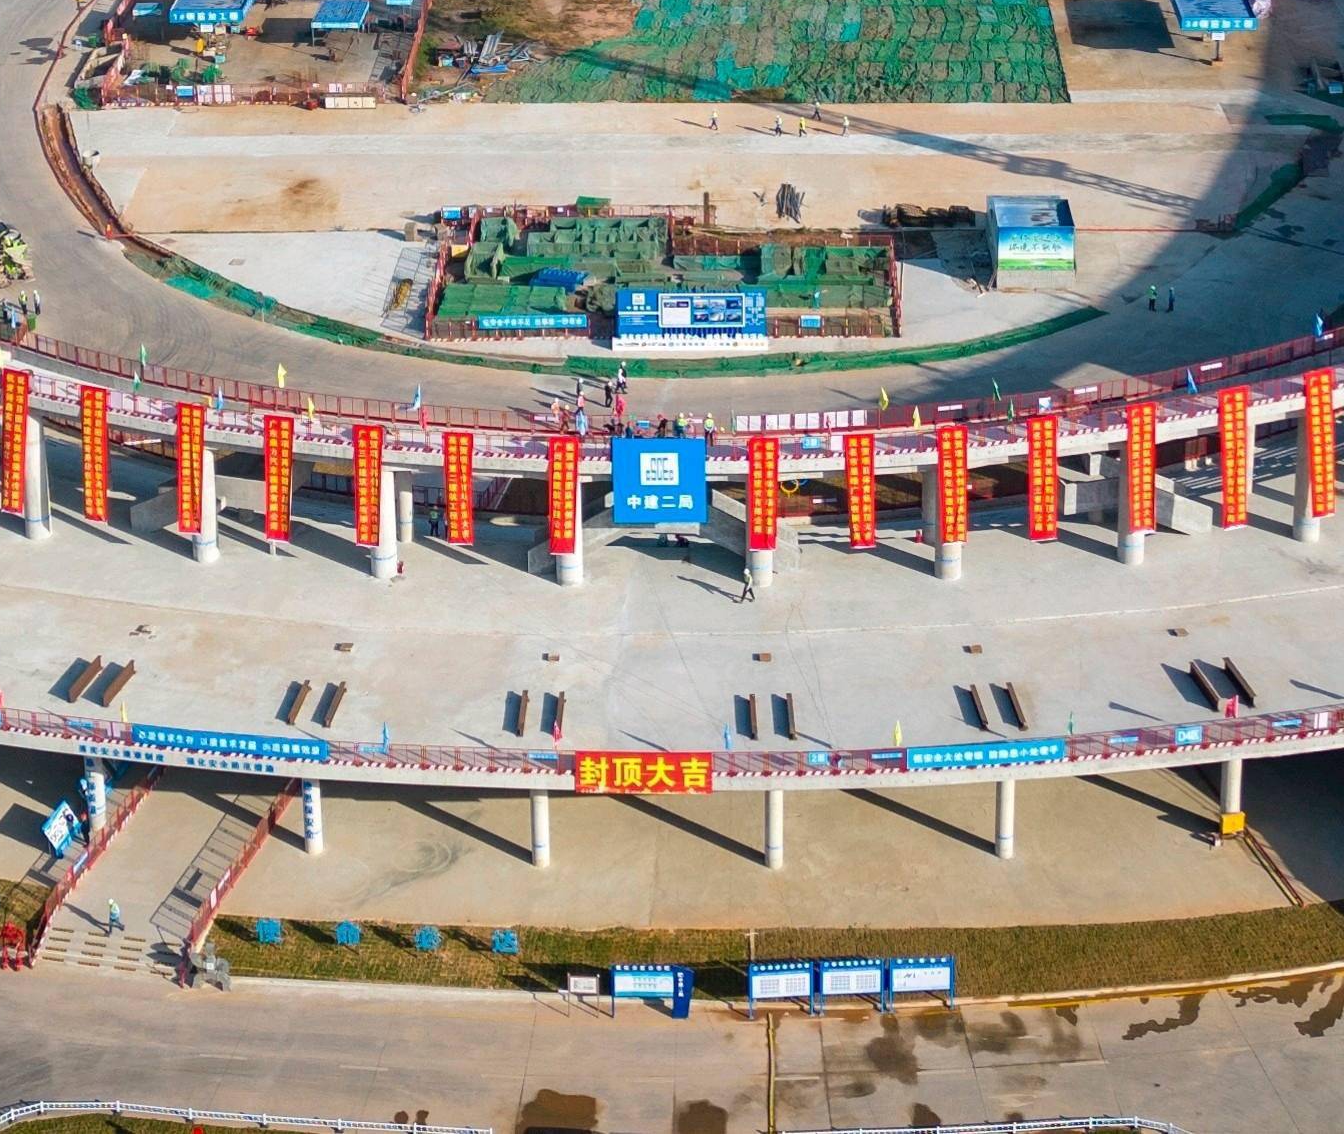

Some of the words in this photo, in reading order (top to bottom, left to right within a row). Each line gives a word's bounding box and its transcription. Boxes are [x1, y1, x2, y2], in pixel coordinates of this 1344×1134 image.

[626, 494, 694, 510] 中建二局
[578, 755, 710, 789] 封顶大吉
